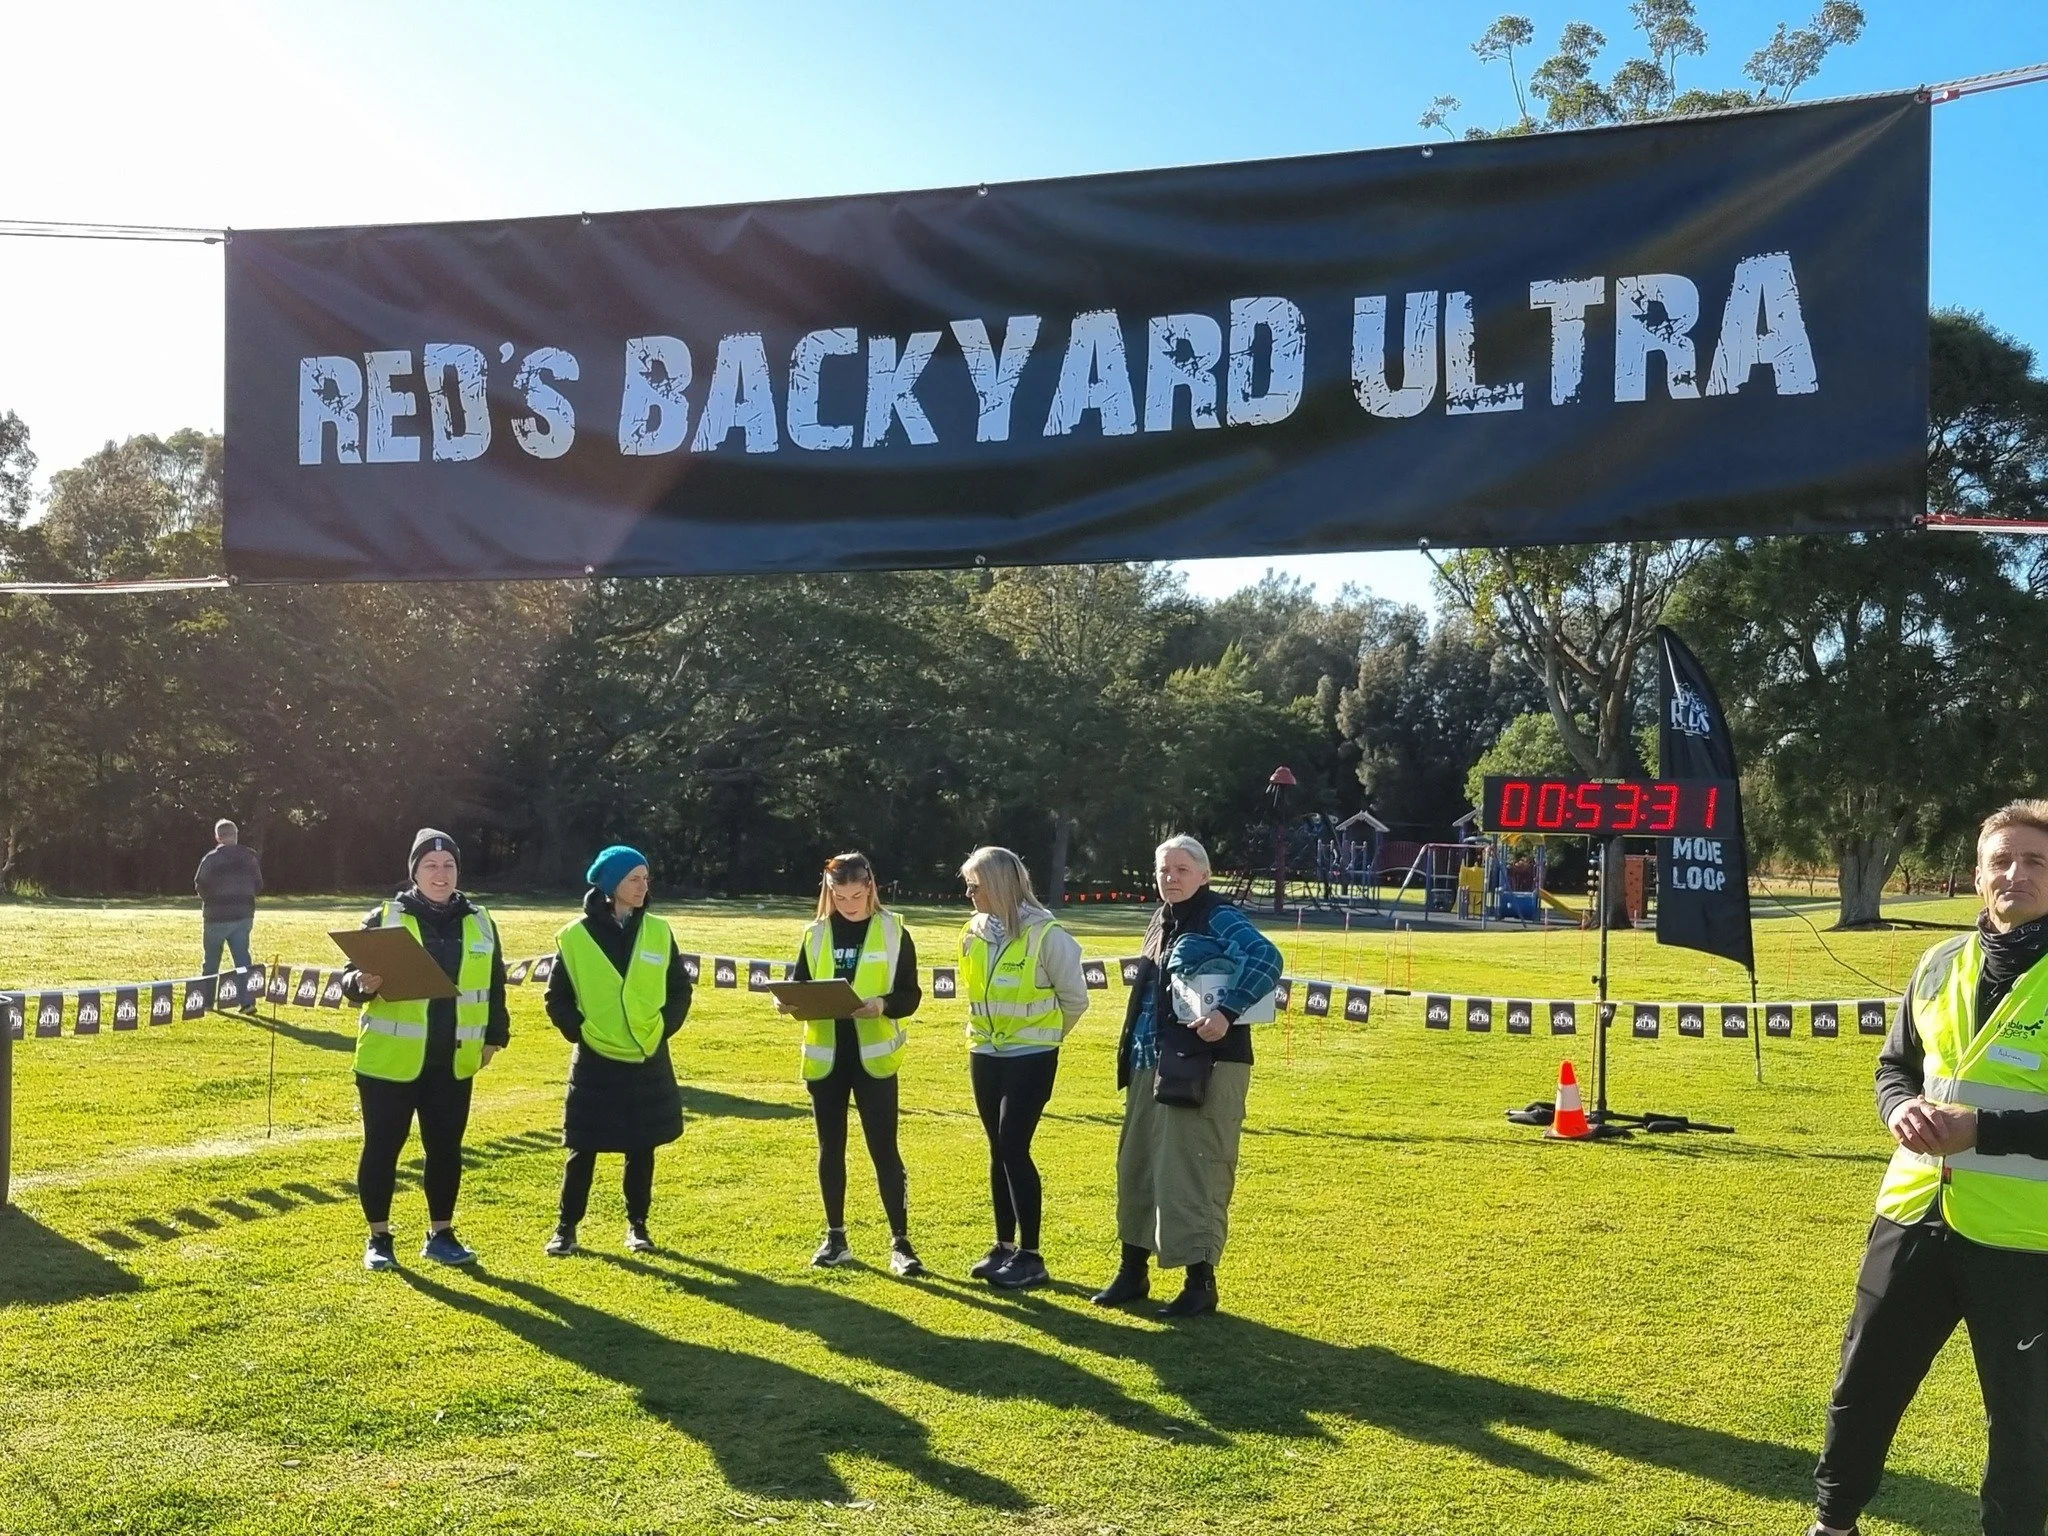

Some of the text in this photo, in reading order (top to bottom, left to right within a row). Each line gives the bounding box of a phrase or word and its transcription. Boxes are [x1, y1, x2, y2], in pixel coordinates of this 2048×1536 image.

[298, 250, 1820, 466] RED'S BACKYARD ULTRA
[1499, 782, 1720, 830] 00:53:31
[1672, 866, 1726, 891] LOOP
